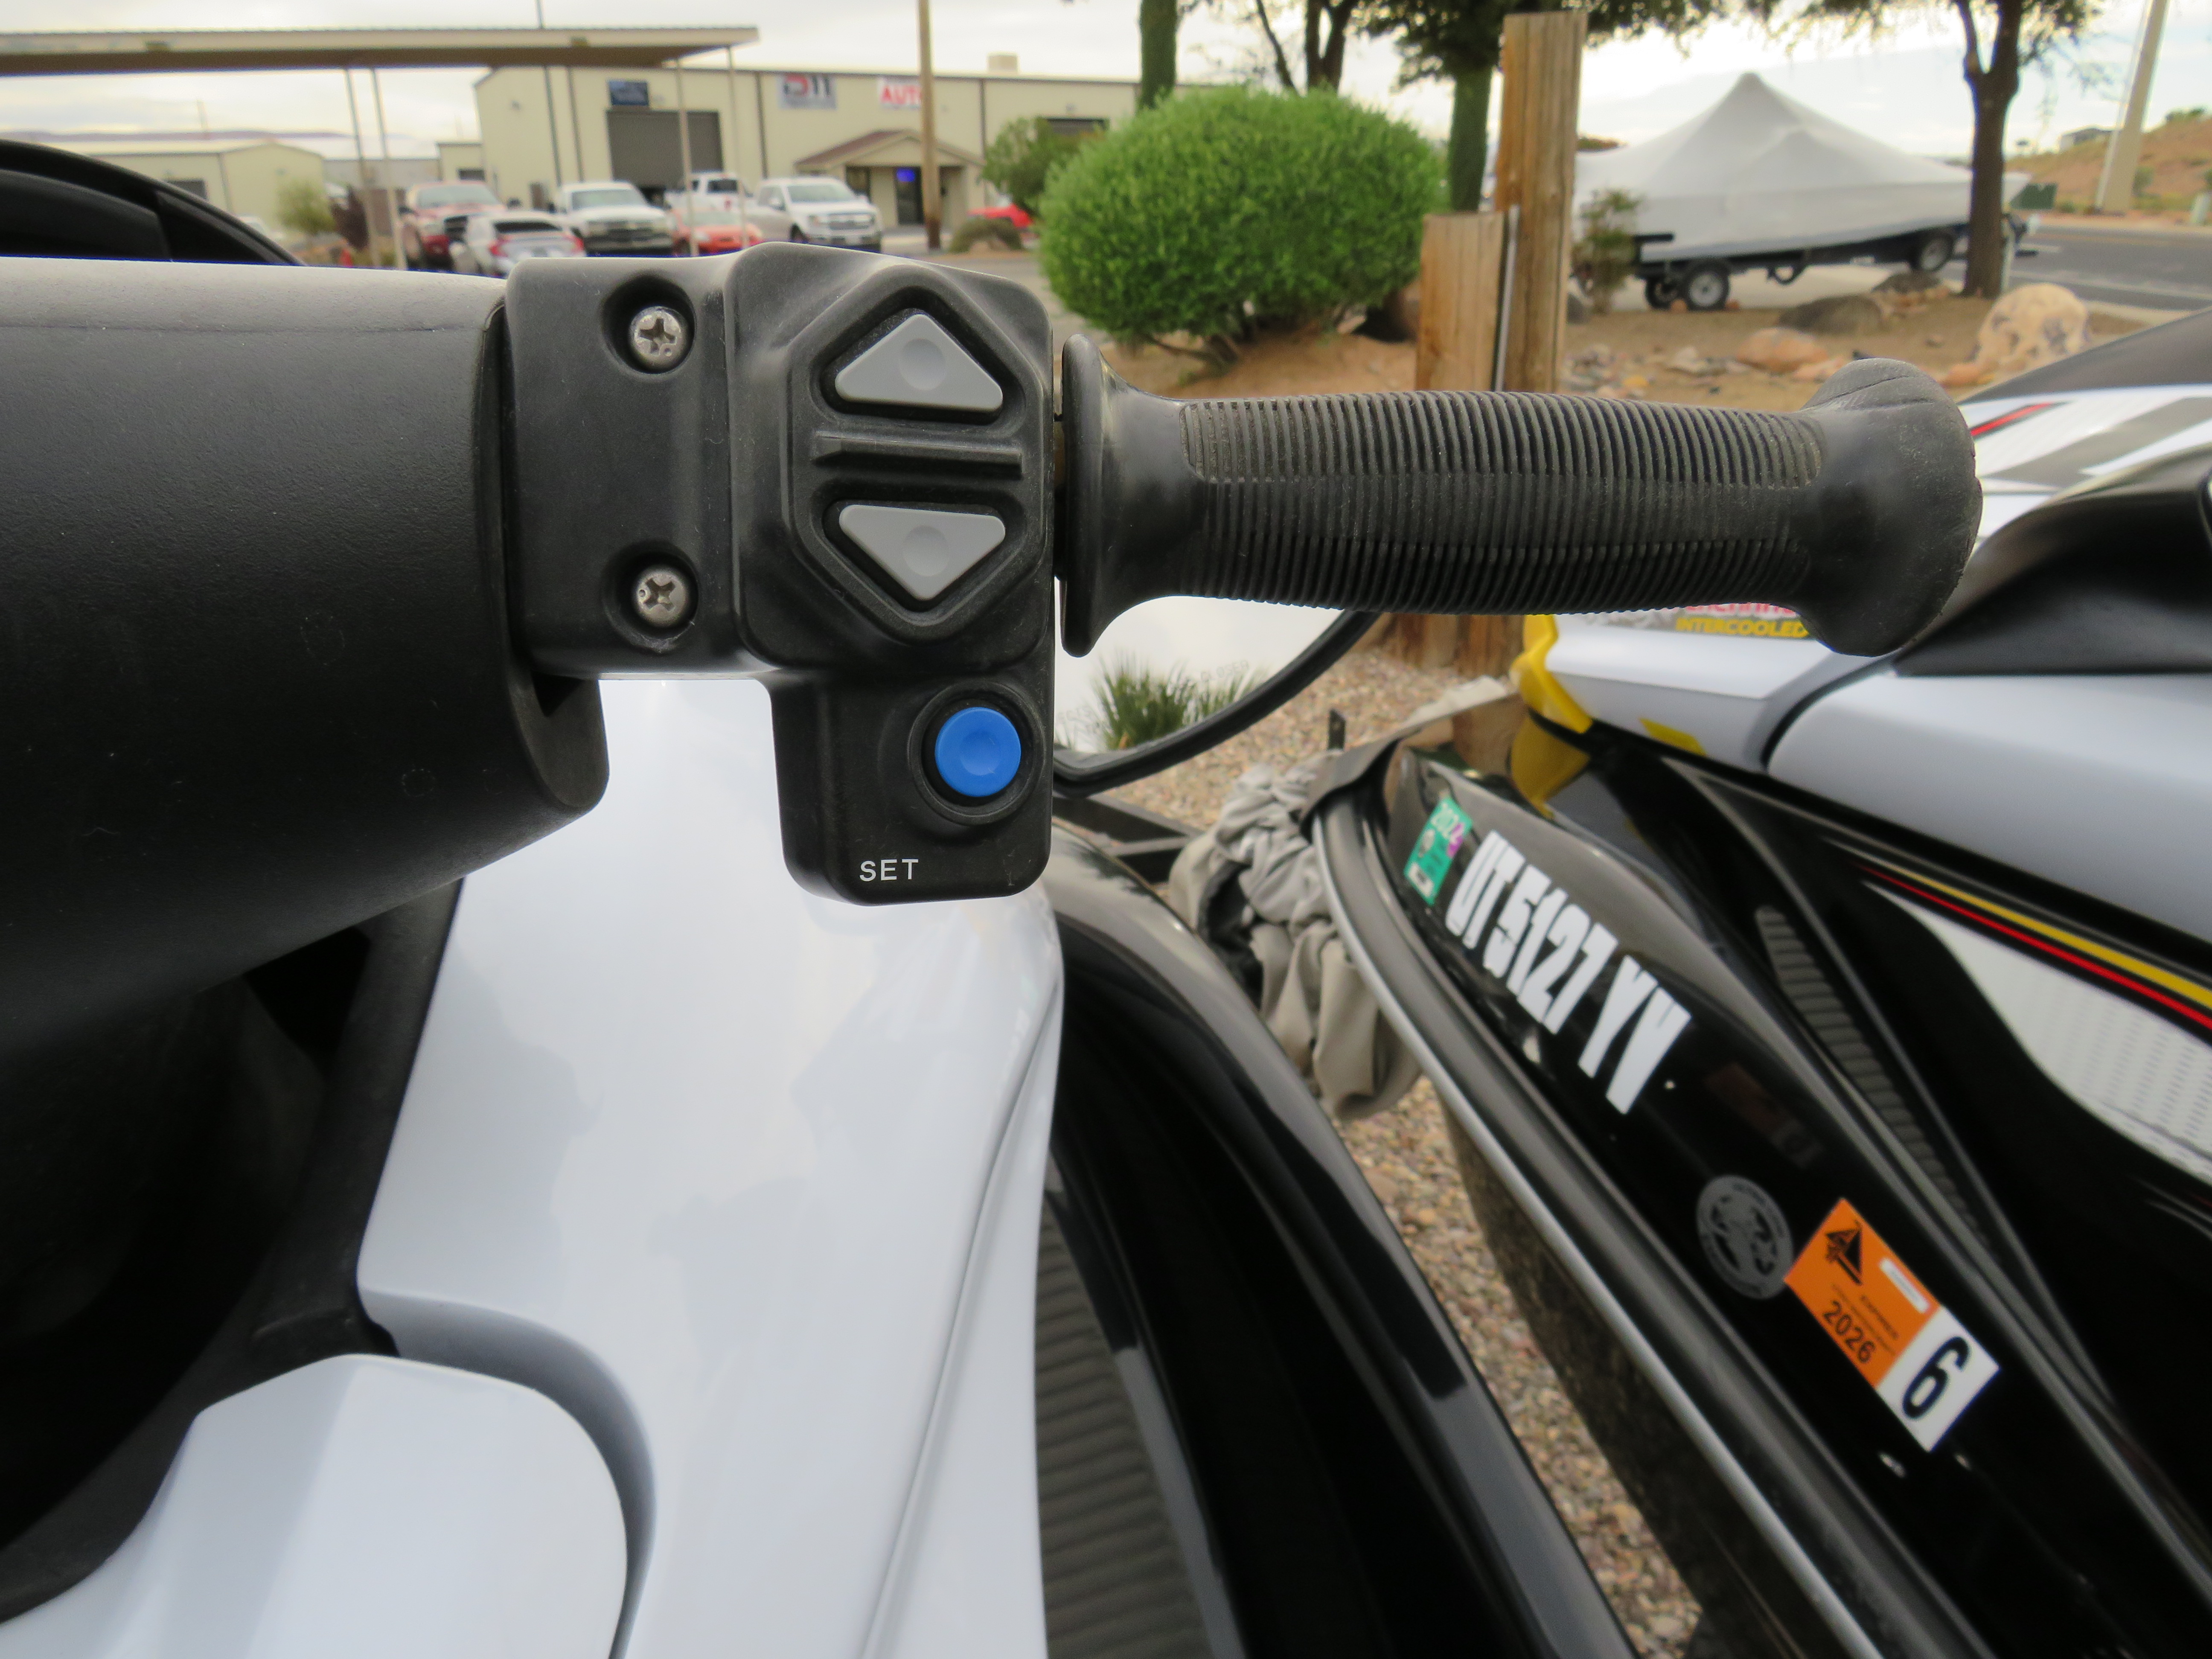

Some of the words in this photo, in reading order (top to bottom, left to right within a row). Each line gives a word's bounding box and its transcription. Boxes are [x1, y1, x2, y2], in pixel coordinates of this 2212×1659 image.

[1676, 617, 1809, 637] INTERCOOLED
[859, 859, 919, 882] SET
[1446, 830, 1525, 949] UT
[1483, 864, 1618, 1035] 5127
[1822, 1300, 1876, 1364] 2026
[1902, 1336, 1973, 1421] 6
